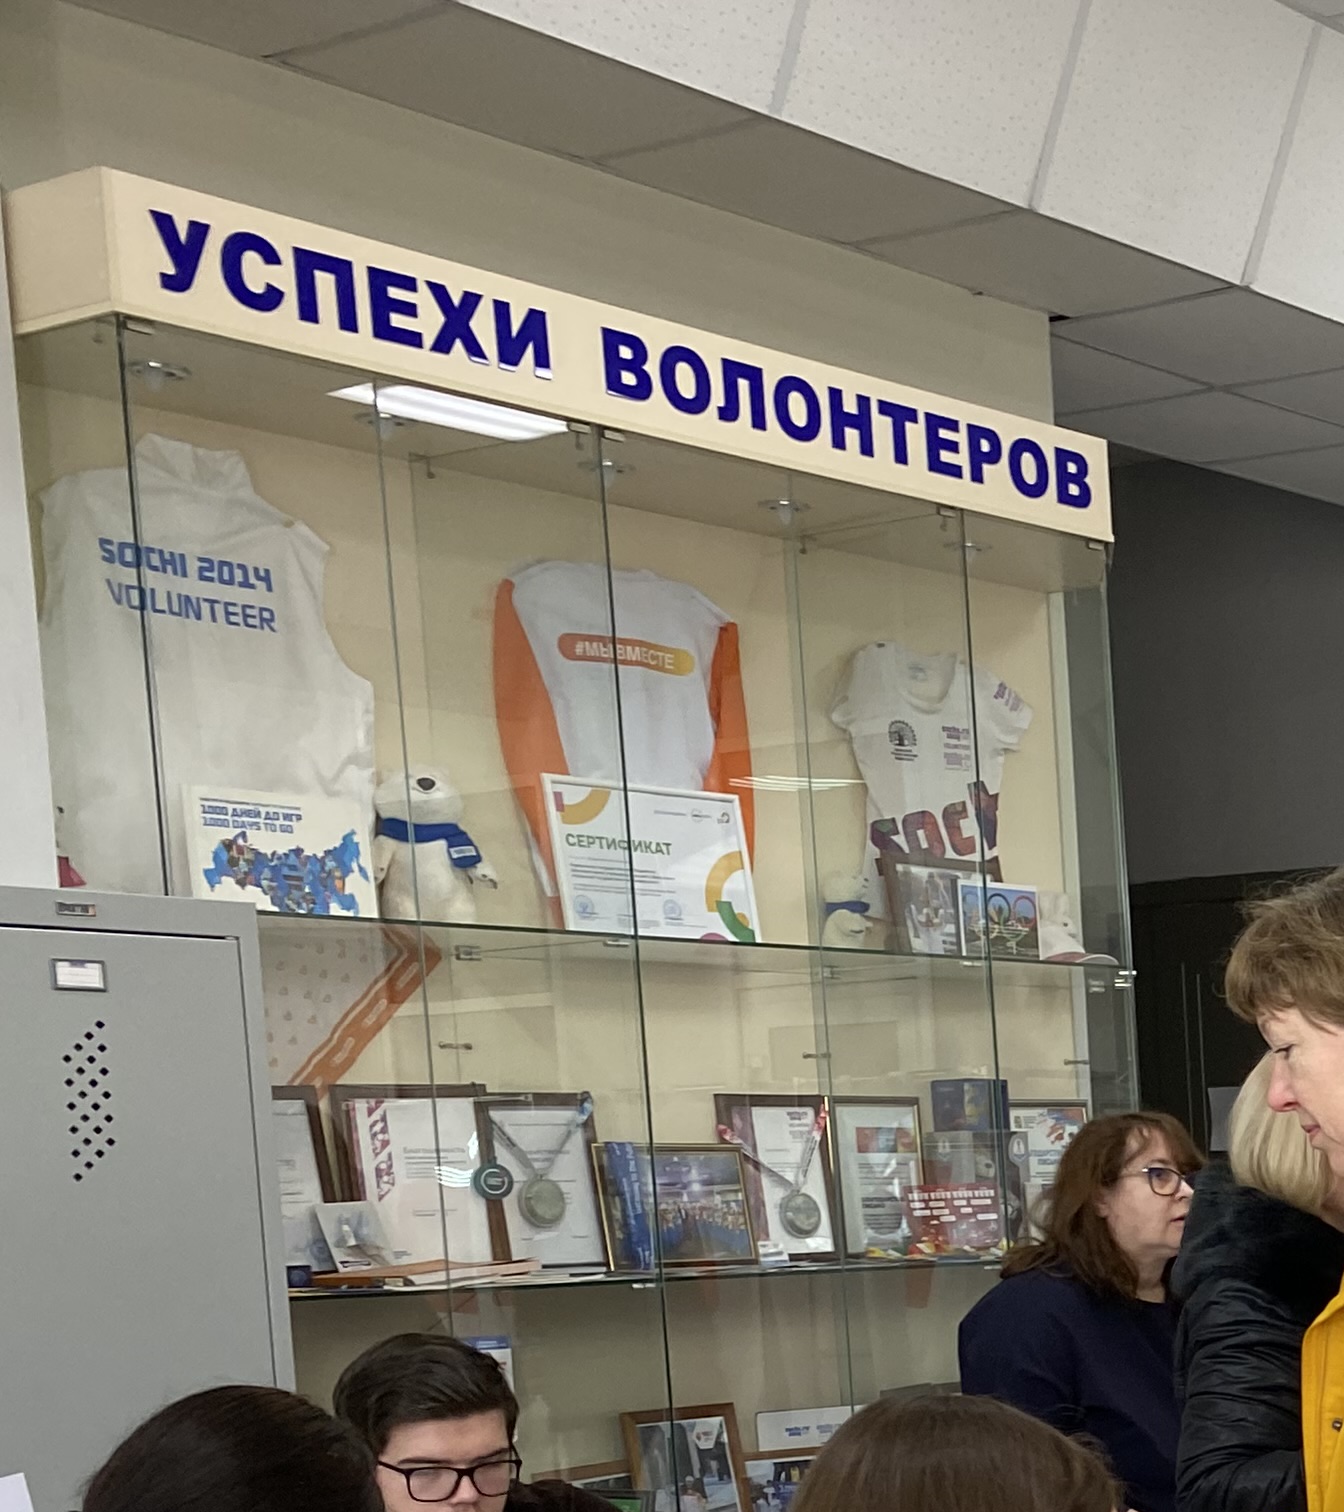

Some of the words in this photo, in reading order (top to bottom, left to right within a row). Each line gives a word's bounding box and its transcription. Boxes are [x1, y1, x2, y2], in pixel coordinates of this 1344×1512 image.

[148, 209, 553, 380] УСПЕХИ
[601, 326, 1092, 509] ВОЛОНТЕРОВ
[98, 537, 188, 578] SOCHI
[197, 555, 273, 592] 2014
[105, 578, 276, 633] VOLUNTEER
